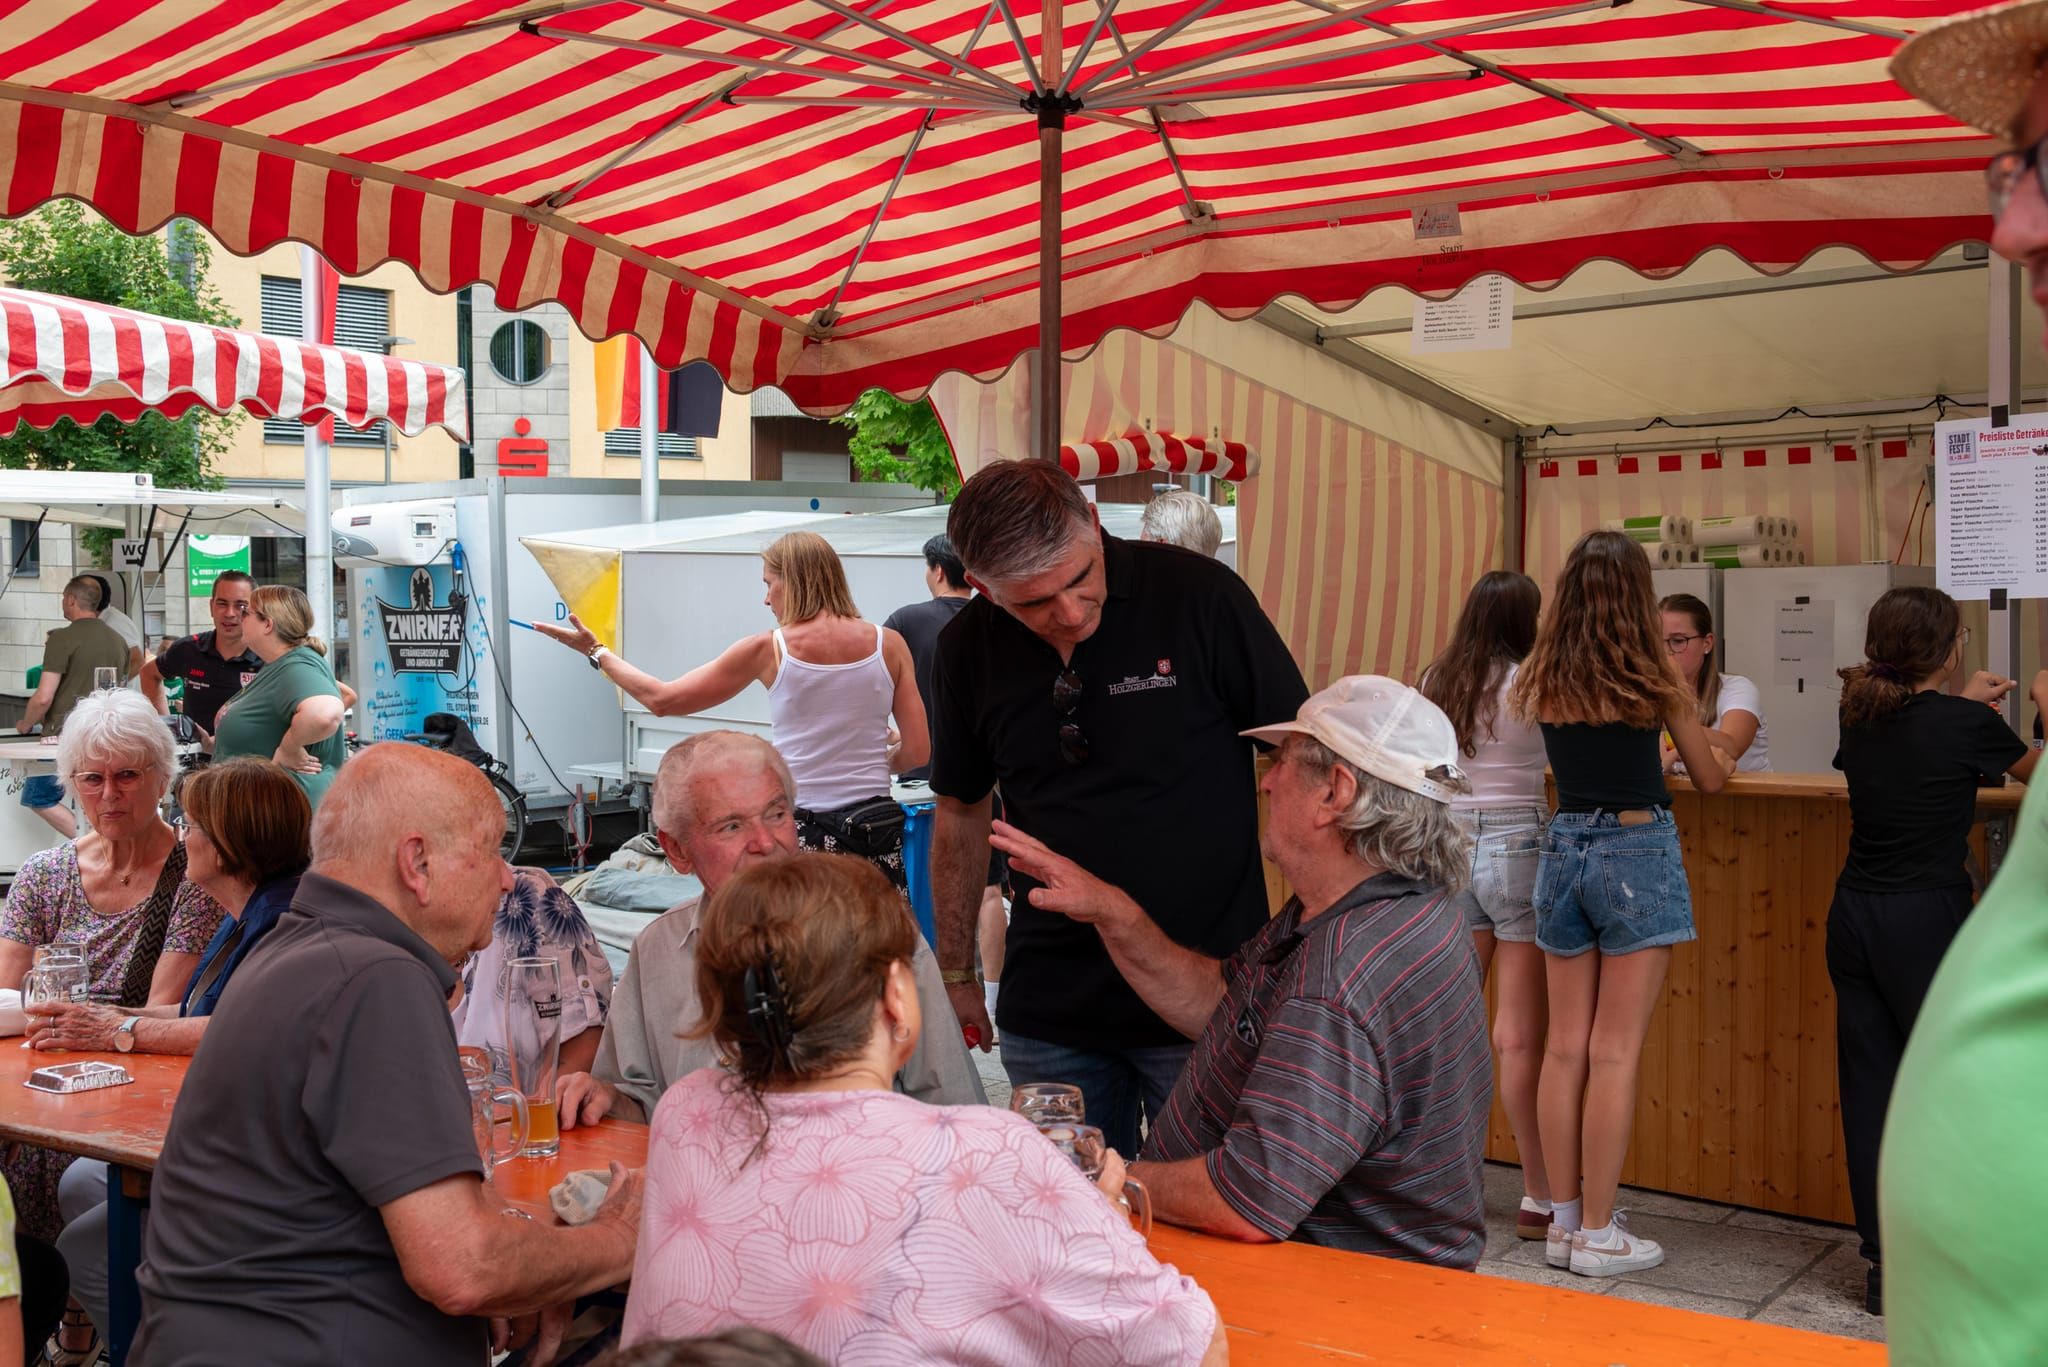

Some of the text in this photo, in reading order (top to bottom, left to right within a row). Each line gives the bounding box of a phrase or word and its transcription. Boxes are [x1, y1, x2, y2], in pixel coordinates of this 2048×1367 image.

[1948, 432, 1970, 444] STADT
[1979, 430, 2014, 442] Preisliste
[1949, 443, 1964, 455] FEST
[385, 613, 462, 640] ZWIRNER
[1108, 676, 1177, 695] HOLZGERLINGEN
